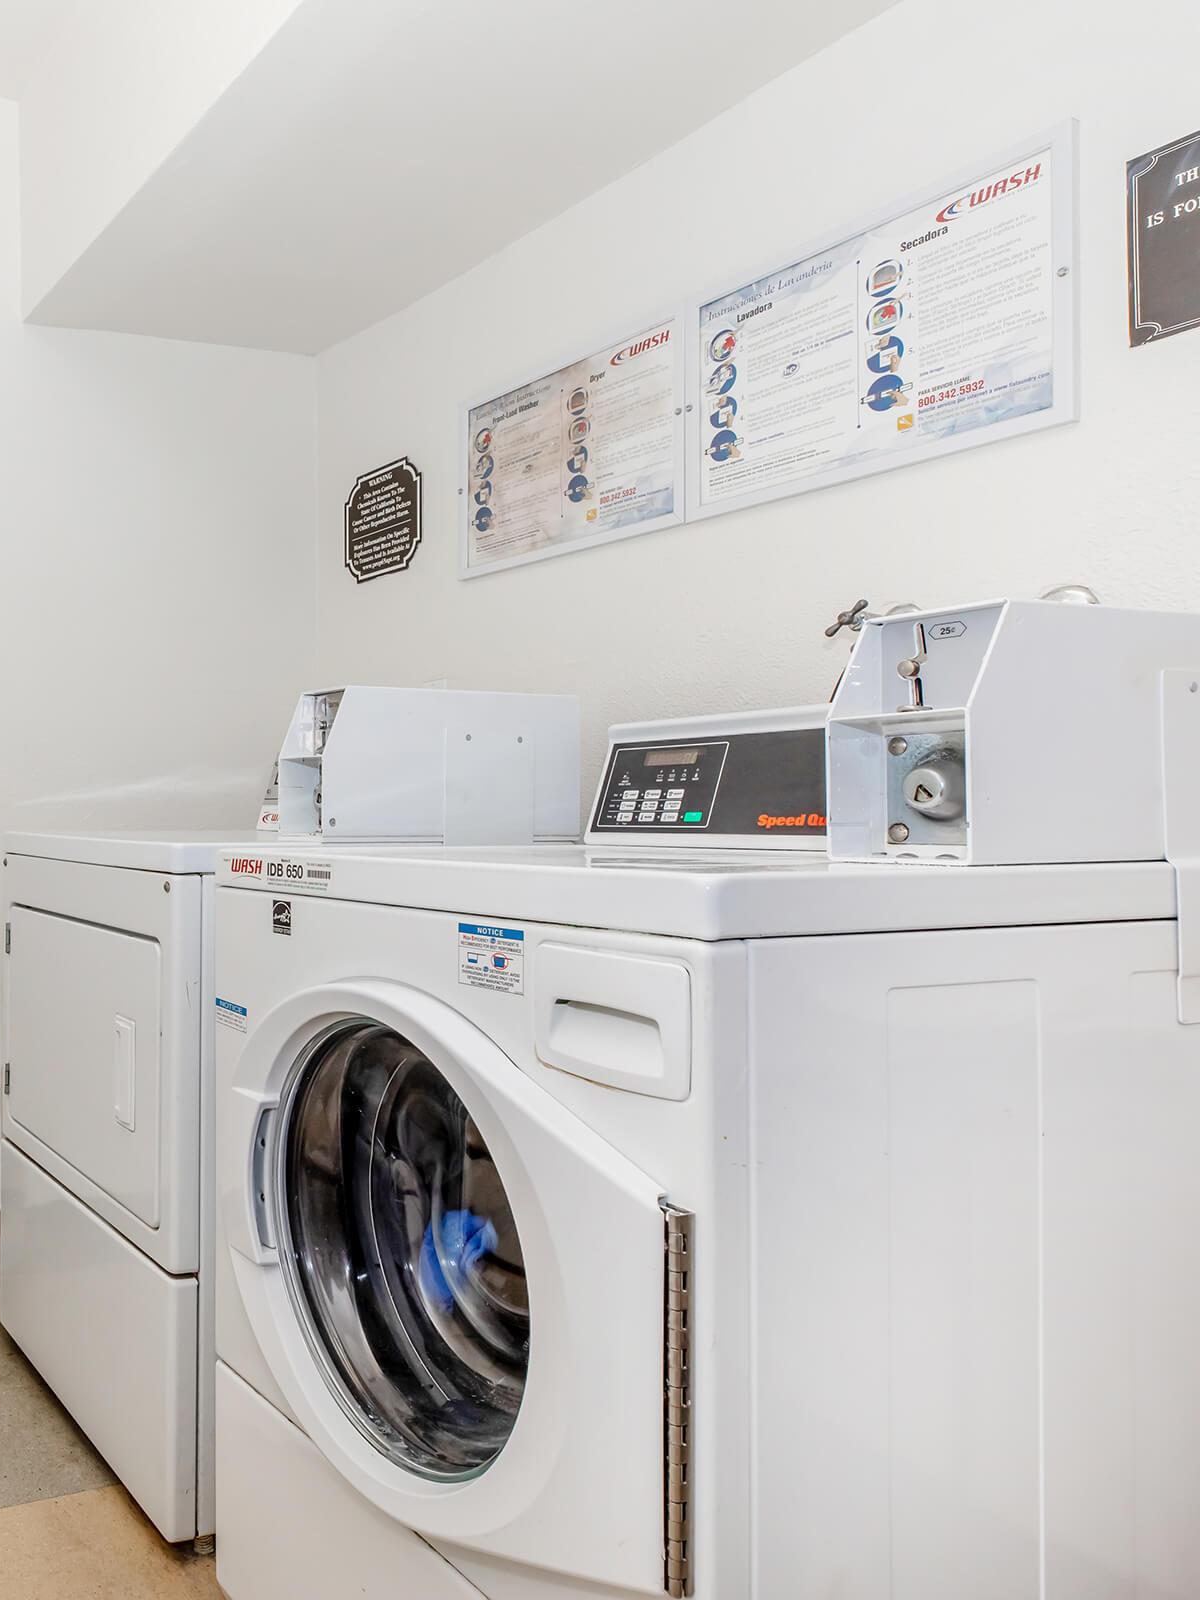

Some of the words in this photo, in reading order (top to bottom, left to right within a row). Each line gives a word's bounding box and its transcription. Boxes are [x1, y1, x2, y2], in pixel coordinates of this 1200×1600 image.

[969, 163, 1041, 208] WASH
[1146, 211, 1165, 229] IS
[1173, 196, 1200, 218] FO
[900, 226, 948, 252] Secadora
[708, 294, 762, 321] Instrucciones
[736, 302, 773, 323] Lavadora
[629, 330, 670, 357] WASH
[589, 371, 606, 383] Dryer
[918, 380, 984, 408] 800.342.5932
[757, 813, 806, 829] Speed
[231, 858, 263, 875] WASH
[267, 862, 284, 877] IDB
[286, 864, 304, 879] 650
[477, 927, 504, 937] NOTICE
